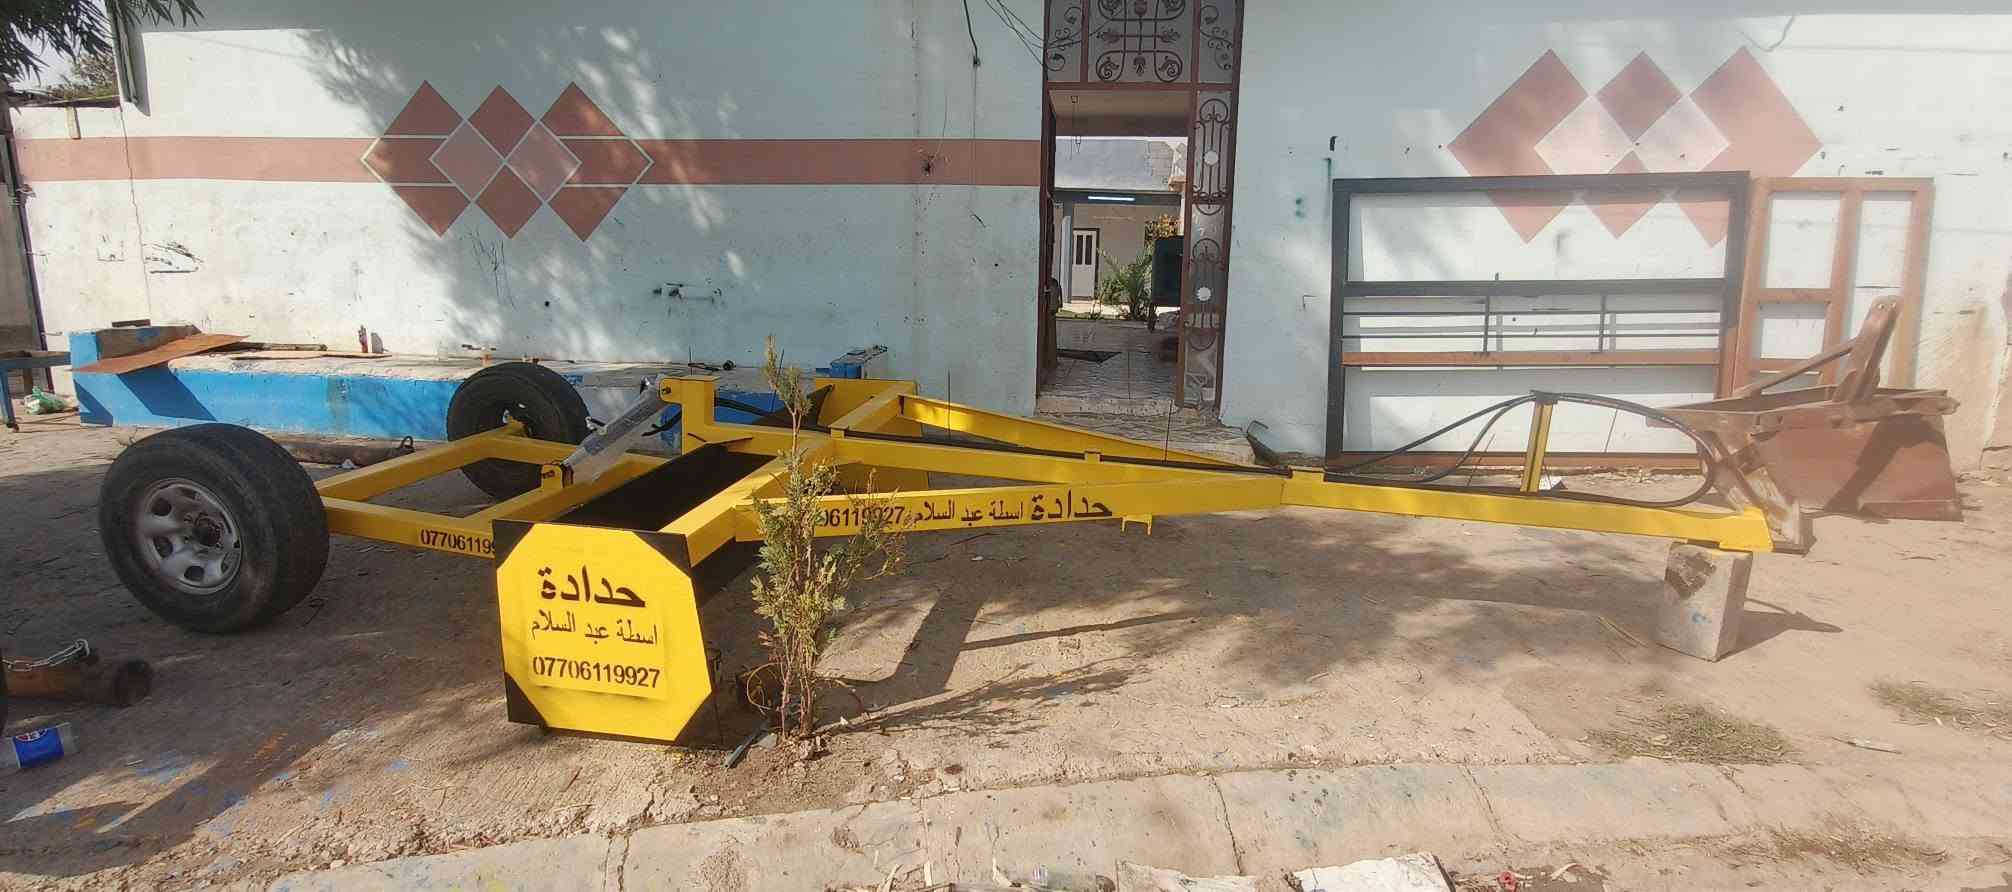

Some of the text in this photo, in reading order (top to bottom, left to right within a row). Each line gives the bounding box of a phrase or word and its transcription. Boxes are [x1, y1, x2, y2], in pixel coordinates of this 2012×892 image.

[960, 506, 983, 526] عبد
[1030, 490, 1113, 521] حدادة
[537, 565, 646, 608] حدادة
[531, 609, 576, 641] السلام
[583, 621, 610, 645] عبد
[532, 656, 661, 688] 07706119927
